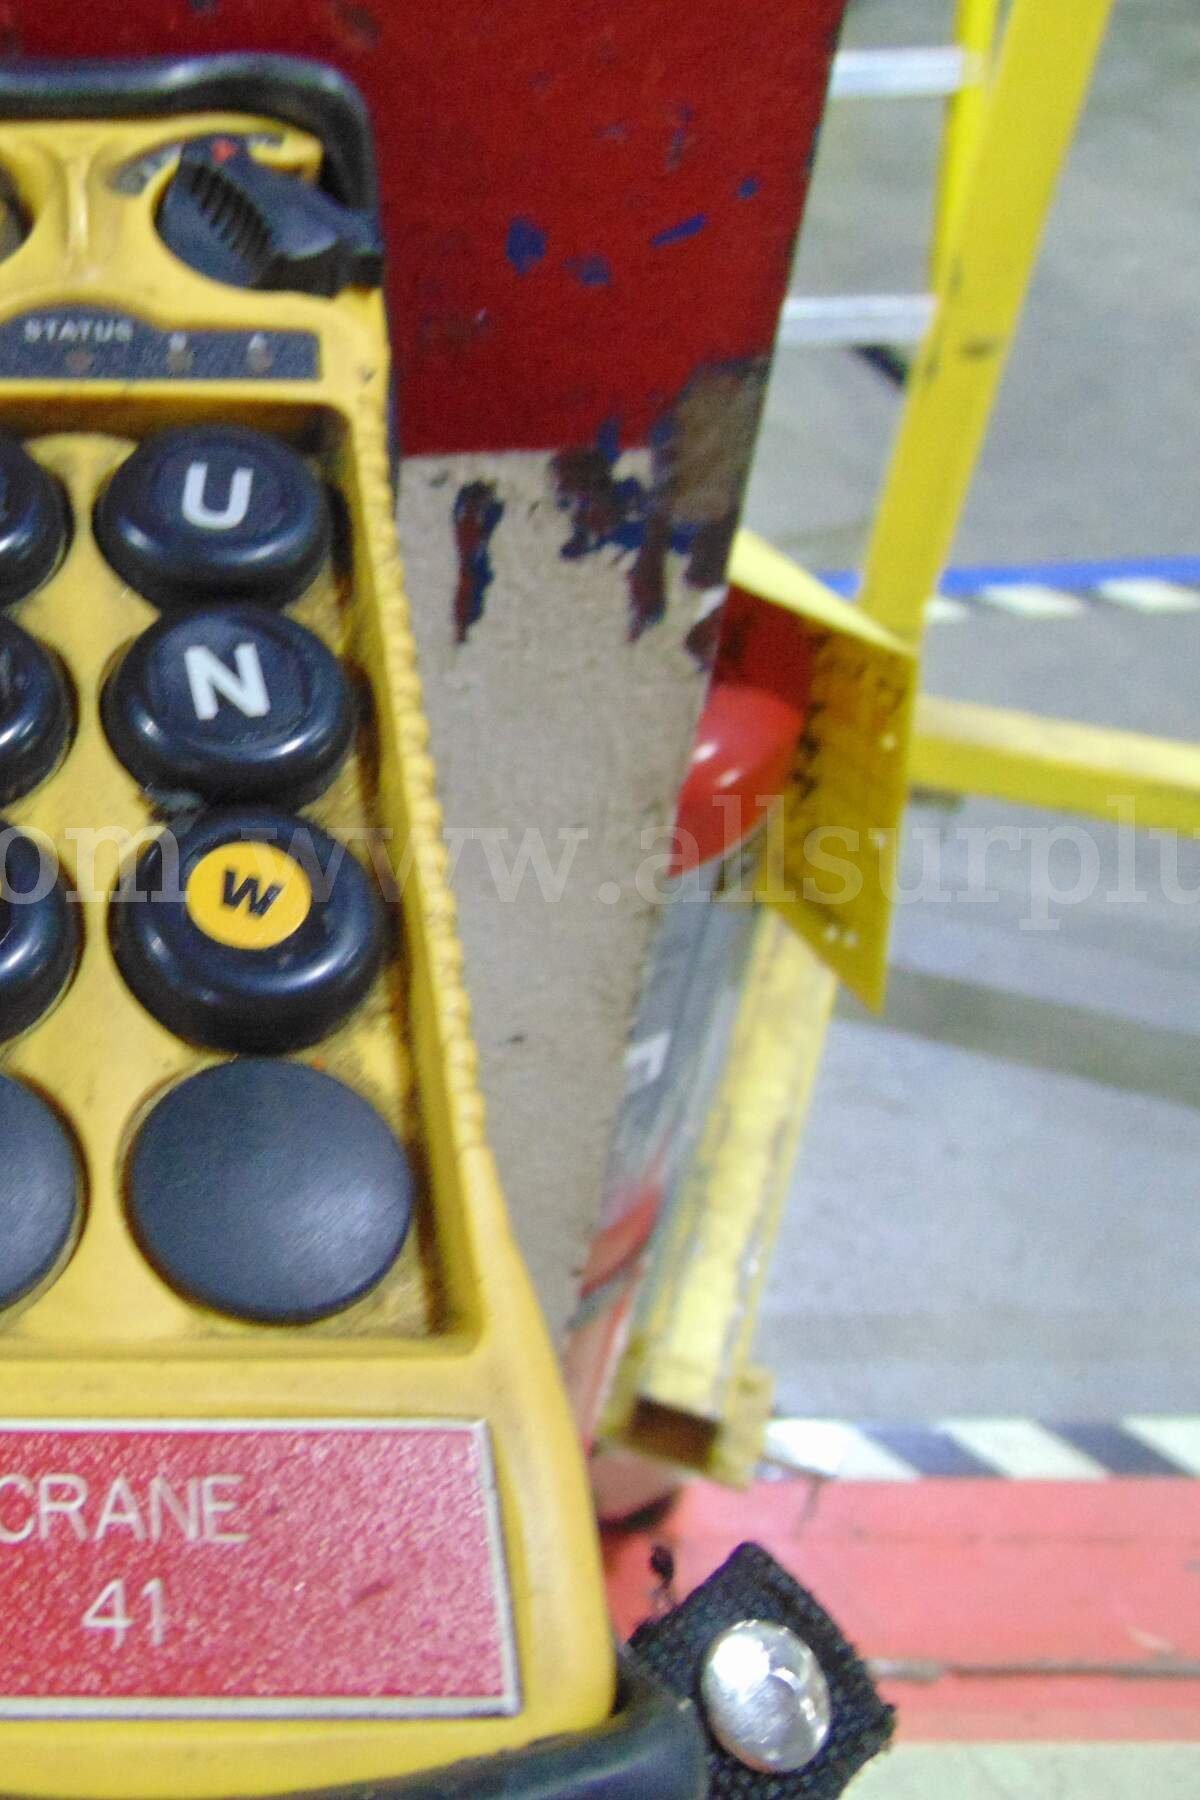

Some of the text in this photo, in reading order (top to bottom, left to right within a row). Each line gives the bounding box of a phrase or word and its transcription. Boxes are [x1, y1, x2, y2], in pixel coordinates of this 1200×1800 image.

[23, 317, 133, 343] STATUS
[181, 462, 253, 530] U
[184, 642, 271, 720] N
[221, 868, 282, 919] W
[81, 1577, 166, 1650] 41
